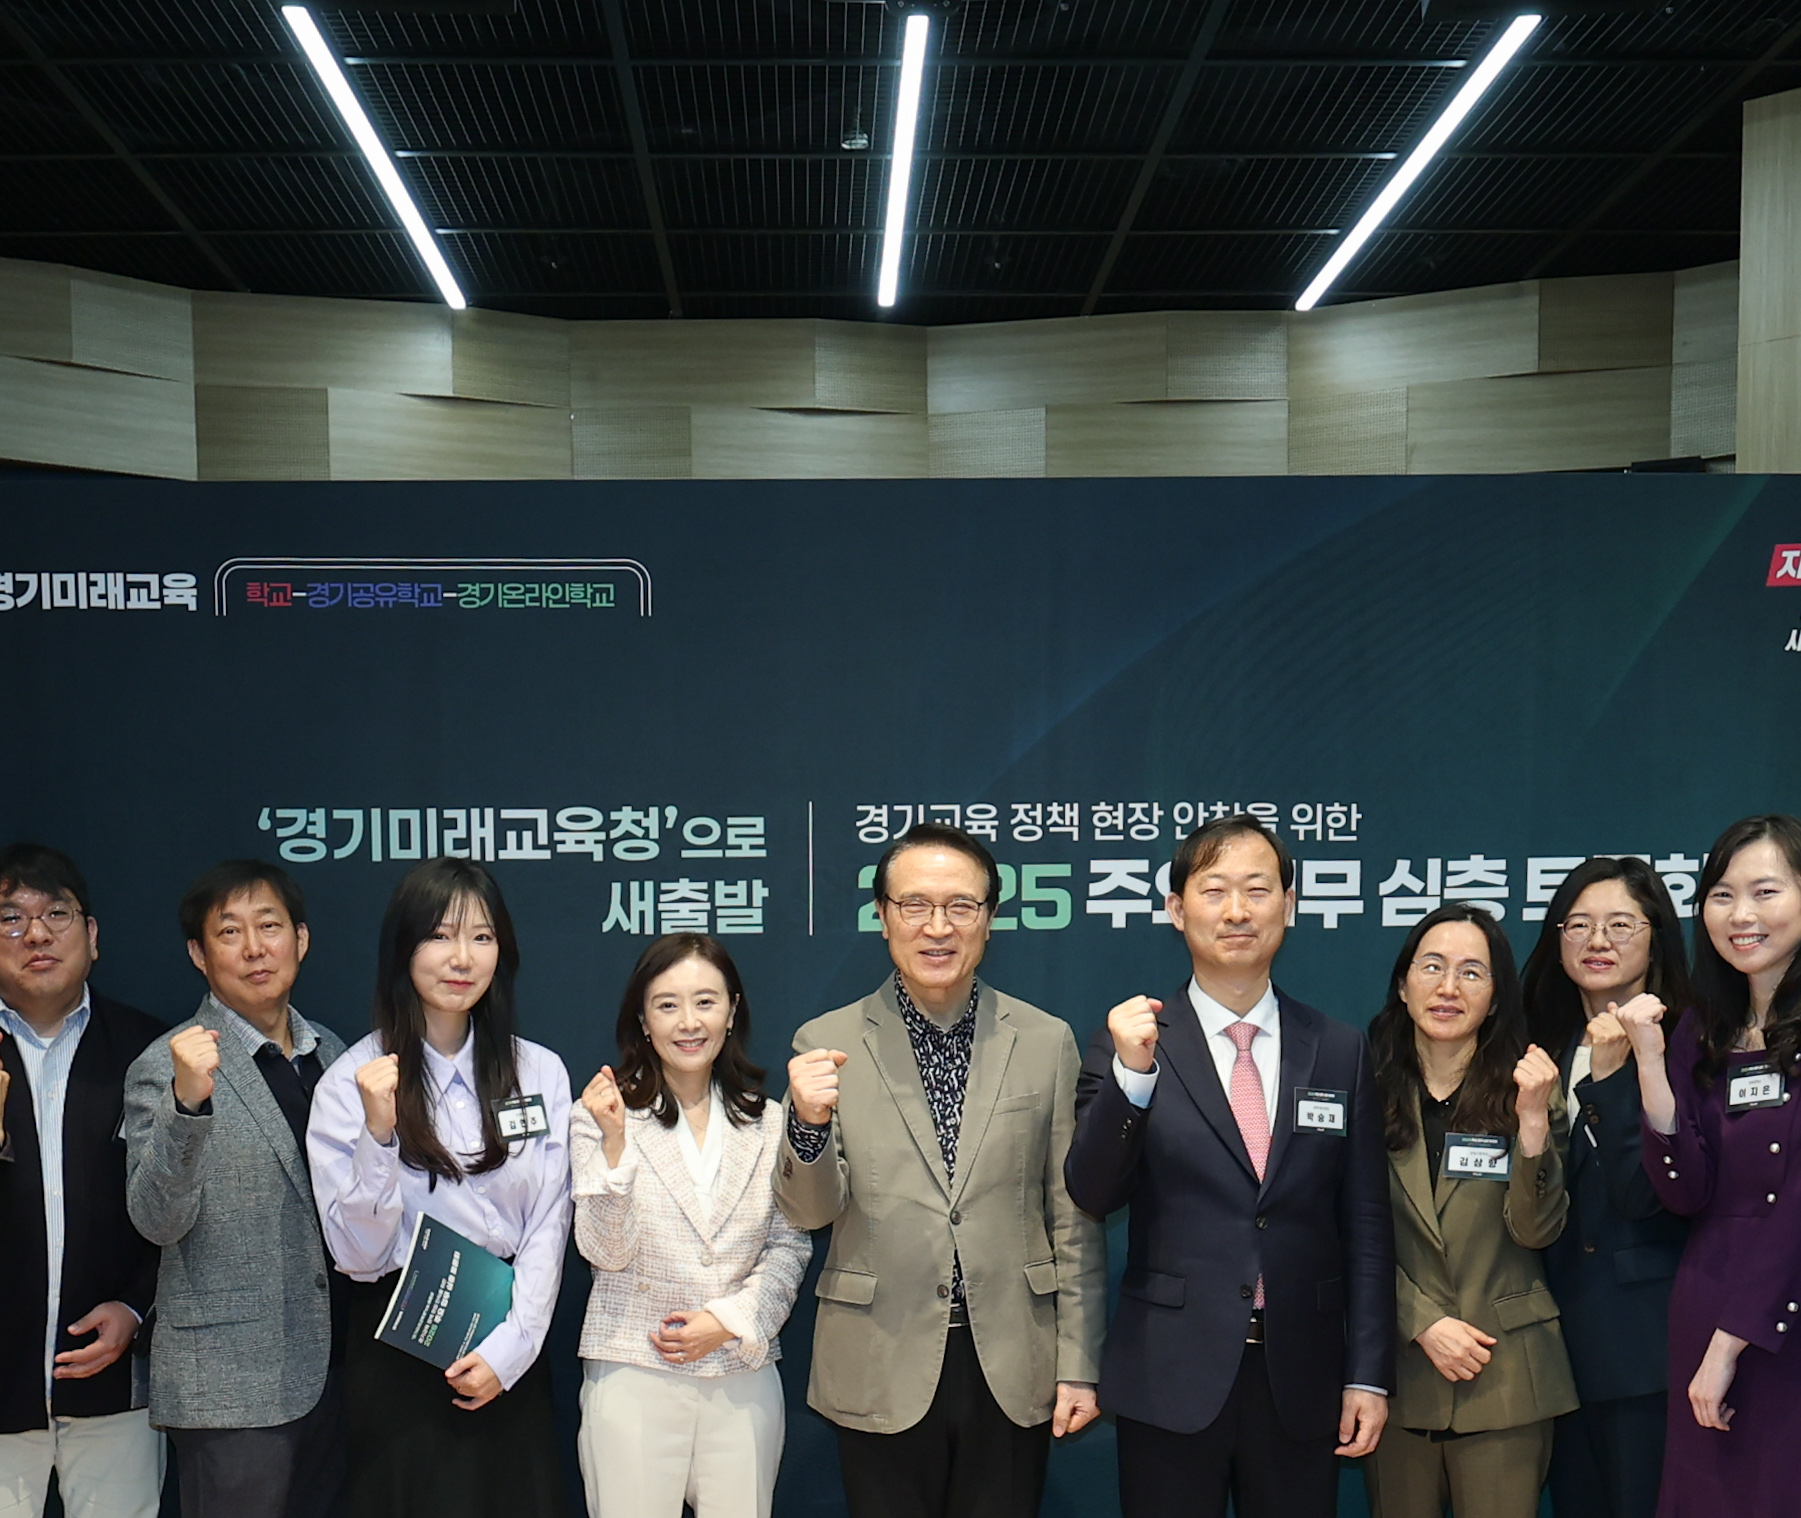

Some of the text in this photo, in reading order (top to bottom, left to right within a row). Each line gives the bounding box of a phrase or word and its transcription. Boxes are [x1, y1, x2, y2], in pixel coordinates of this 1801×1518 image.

[1010, 801, 1081, 843] 정책
[1091, 801, 1165, 842] 현장
[1290, 802, 1363, 842] 위한
[601, 877, 770, 936] 새출발
[1379, 854, 1510, 928] 심층
